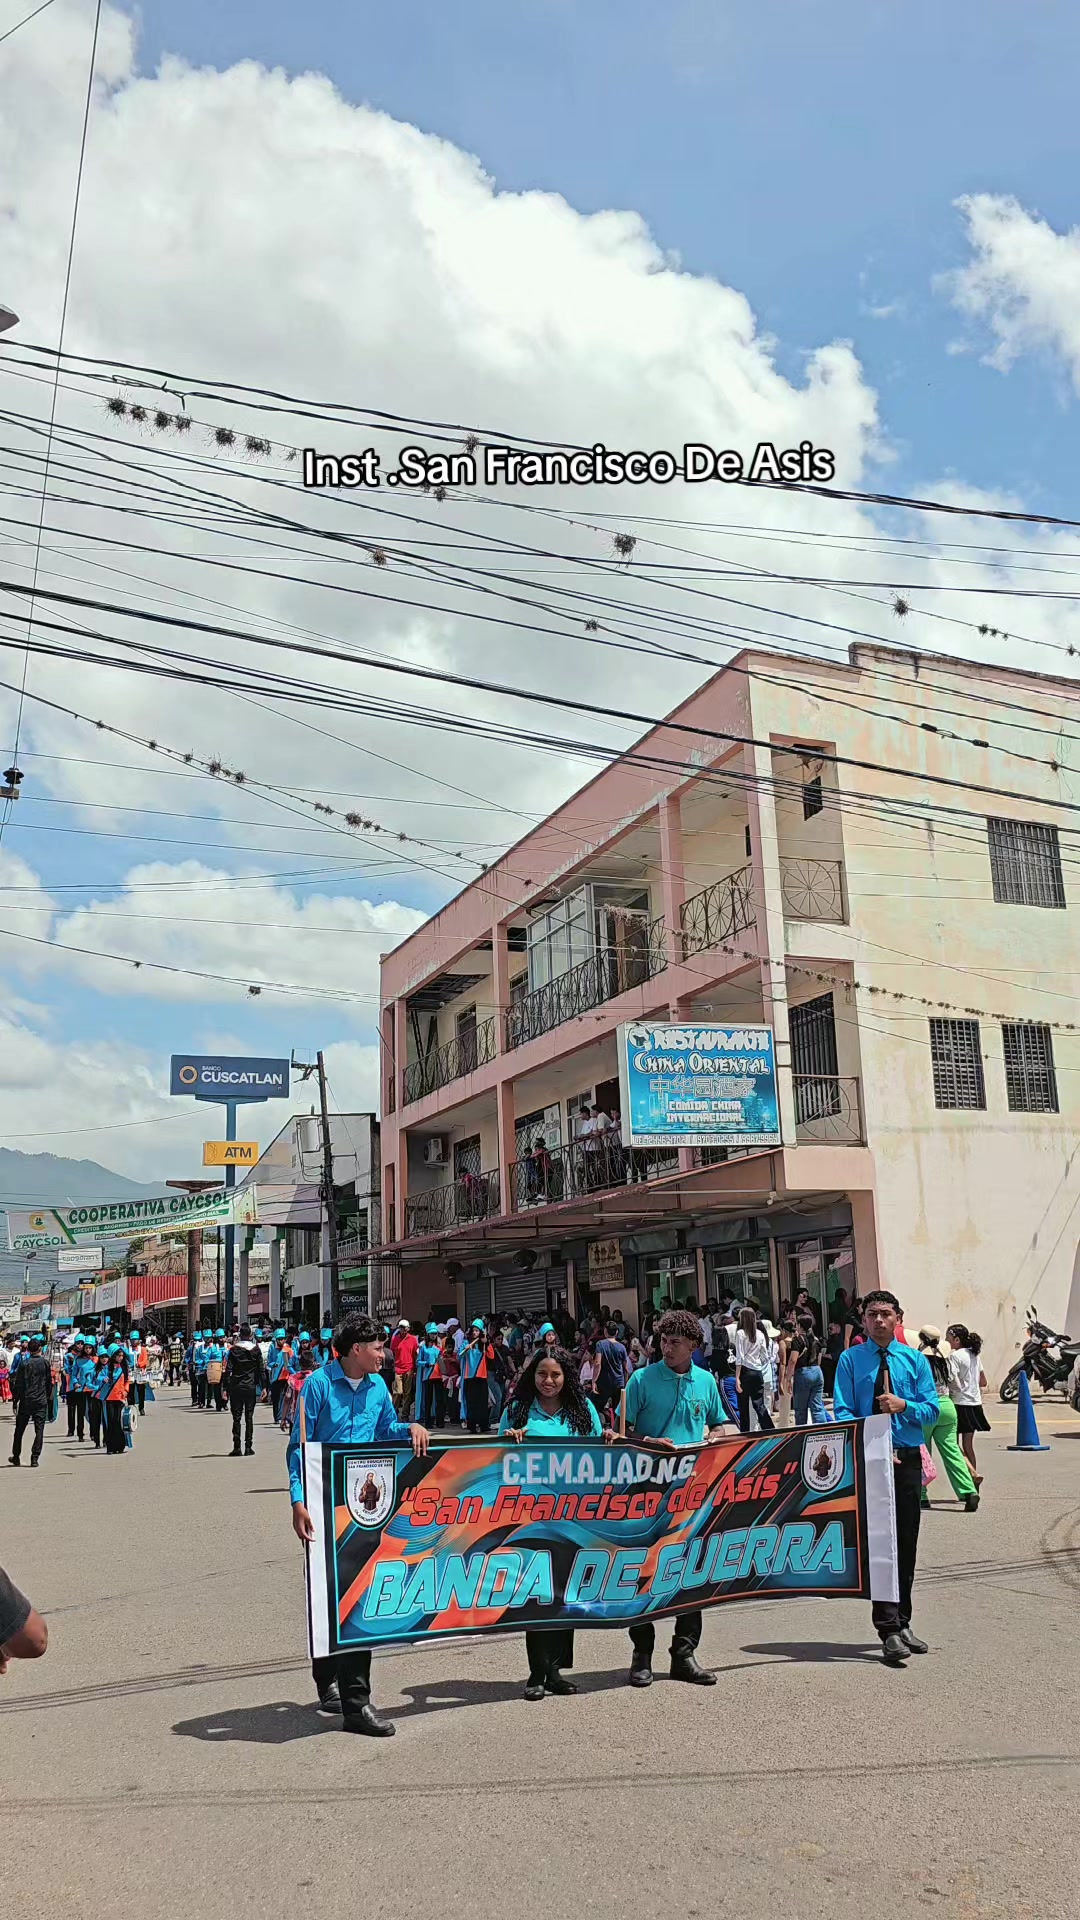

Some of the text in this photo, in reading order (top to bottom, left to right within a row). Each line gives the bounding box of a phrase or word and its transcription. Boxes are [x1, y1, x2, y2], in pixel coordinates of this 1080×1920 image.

[201, 1071, 282, 1084] CUSCATLAN
[668, 1100, 742, 1111] COMIDA CHINA
[666, 1113, 745, 1122] INTERNACIONAL
[224, 1147, 252, 1158] ATM
[69, 1201, 165, 1225] COOPERATIVA
[169, 1191, 230, 1213] CAYCSOL
[13, 1236, 67, 1248] CAYCSOL
[489, 1484, 662, 1523] Francisco
[667, 1477, 707, 1513] de
[364, 1522, 847, 1620] BANDA DE GUERRA
